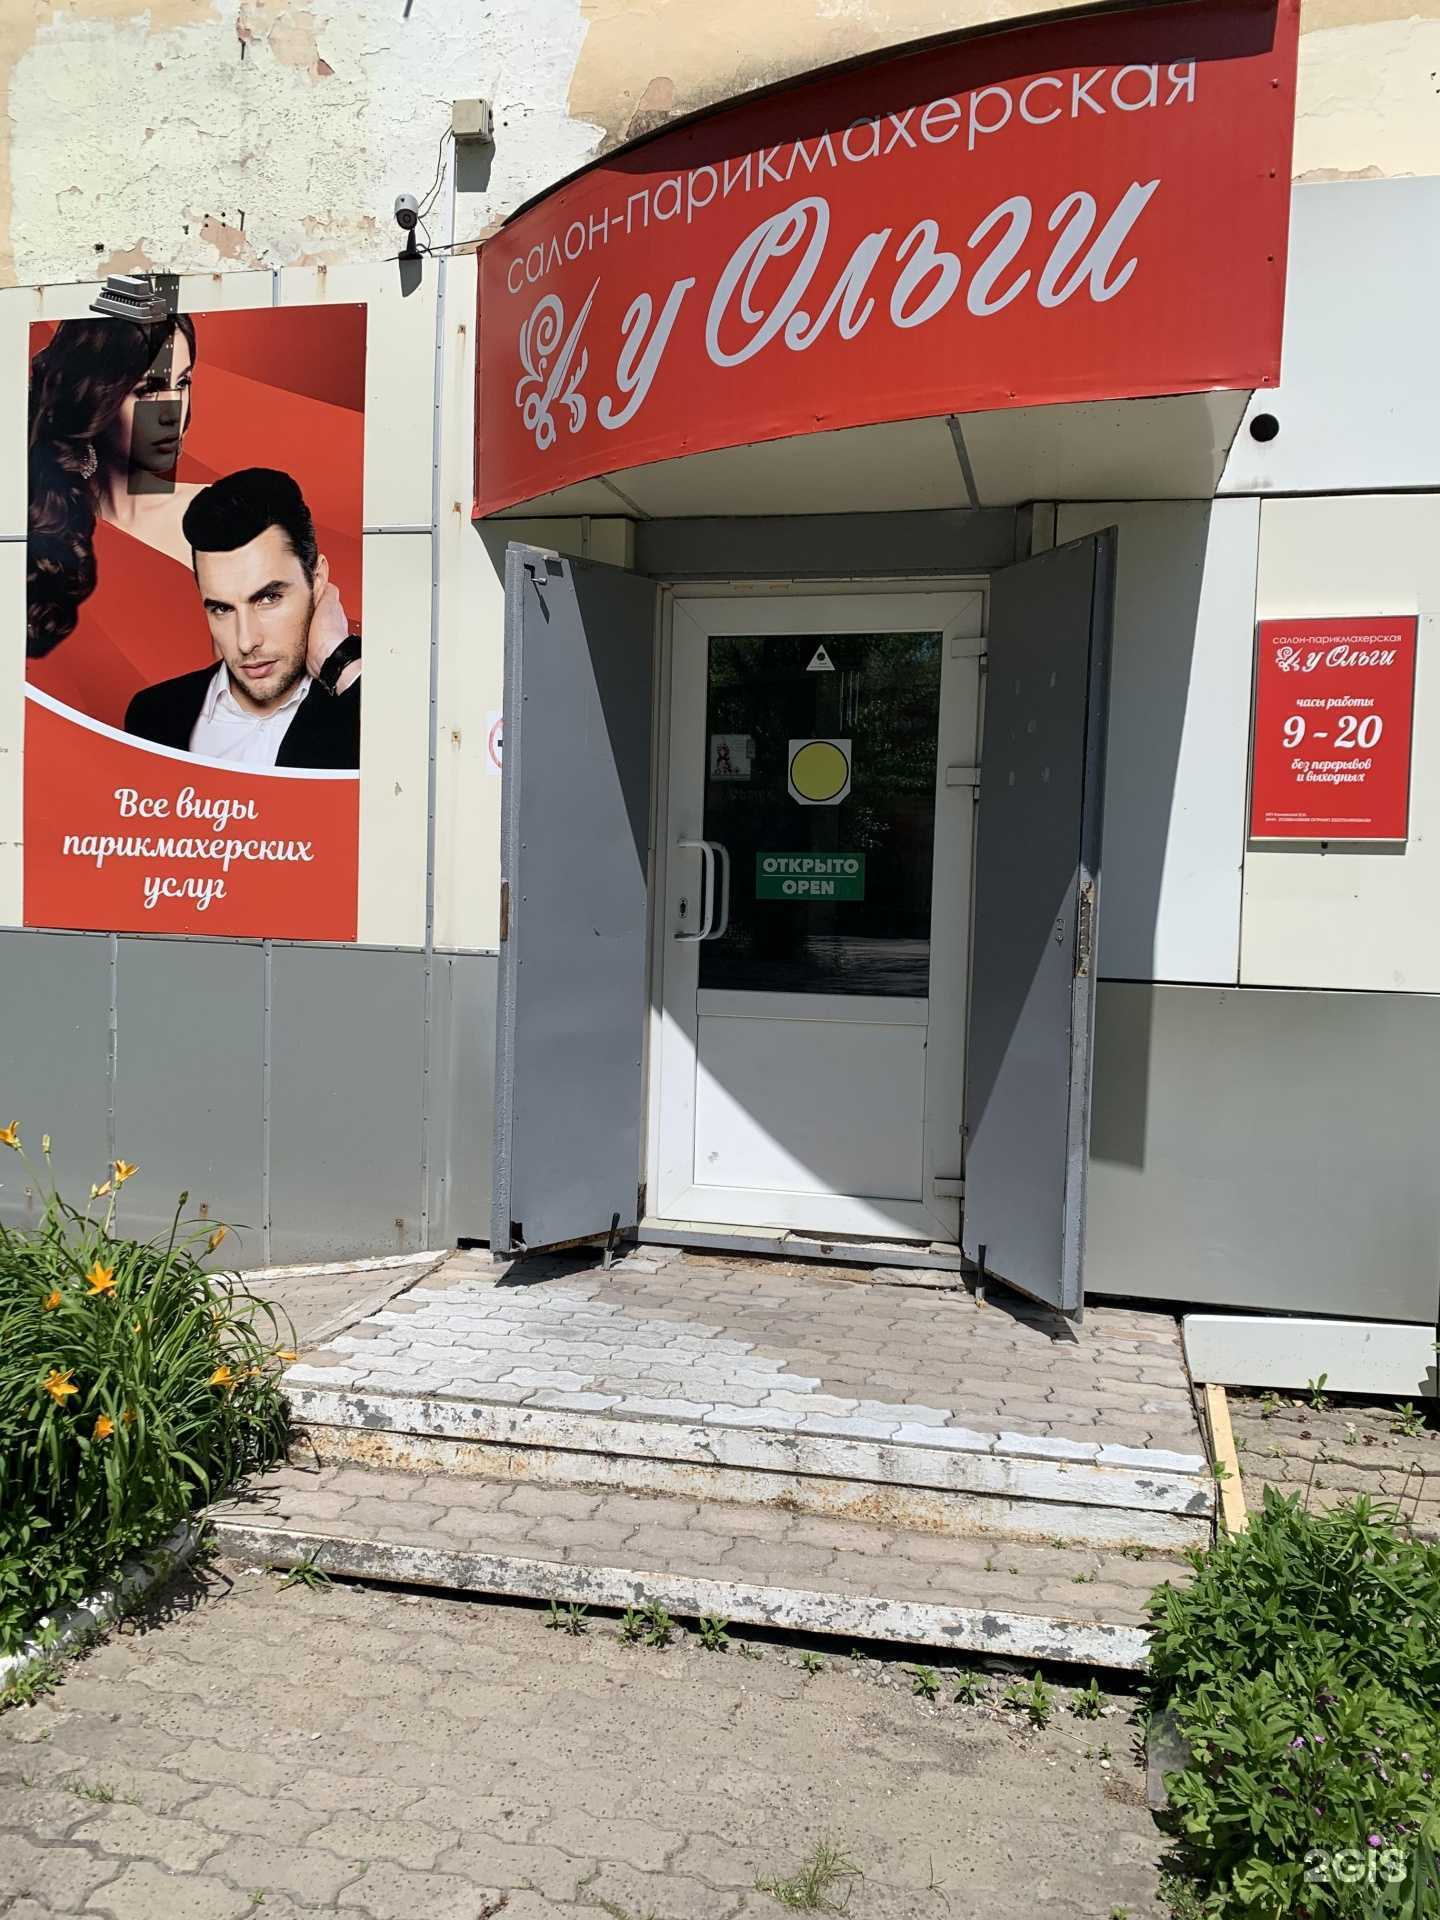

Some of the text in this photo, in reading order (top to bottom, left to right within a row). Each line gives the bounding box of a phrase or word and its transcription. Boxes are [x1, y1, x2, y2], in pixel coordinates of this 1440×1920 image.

[506, 57, 1198, 295] салон-парикмахерская
[598, 178, 1160, 430] у Ольги
[1272, 634, 1402, 645] салон-парикмахерская
[1301, 645, 1398, 673] у Ольги
[1296, 695, 1374, 710] часы работы
[1282, 715, 1306, 748] 9
[1333, 715, 1383, 748] 20
[1291, 758, 1372, 773] без перерывов
[1296, 771, 1365, 785] и выходных
[114, 786, 259, 833] Все виды
[62, 834, 315, 873] парикмахерских
[762, 857, 860, 874] ОТКРЫТО
[143, 876, 227, 911] услуг
[782, 879, 835, 896] OPEN
